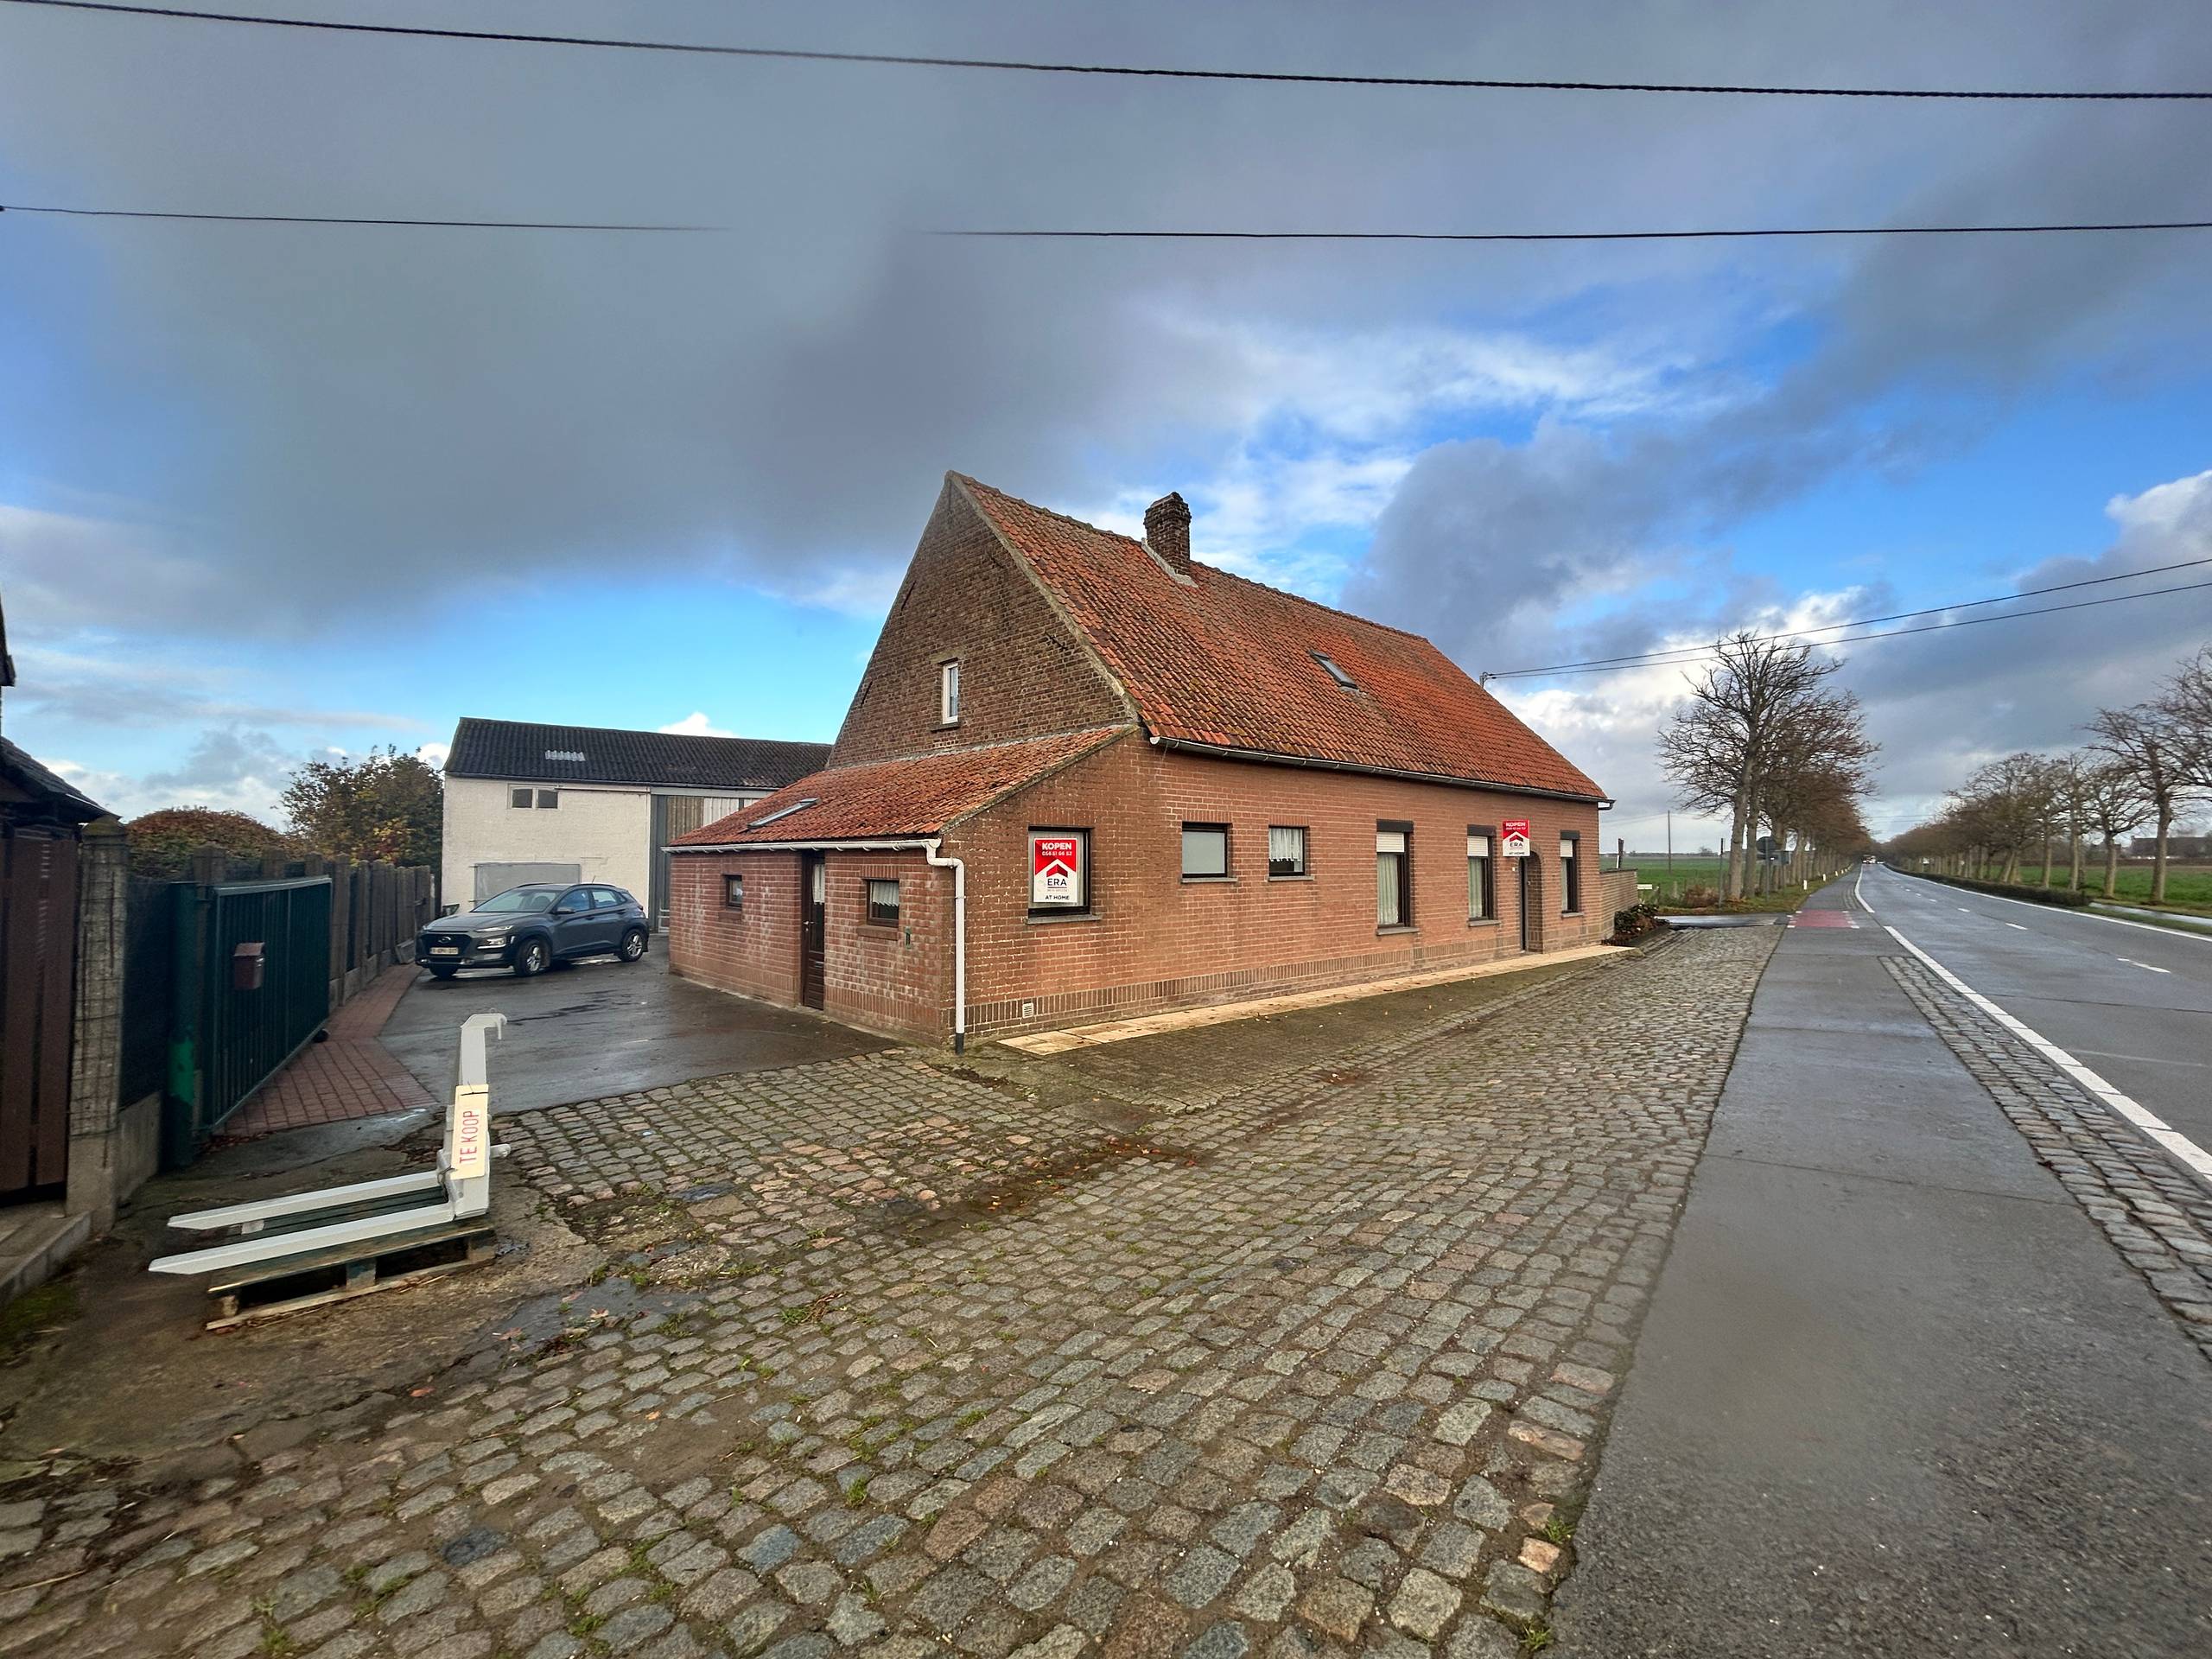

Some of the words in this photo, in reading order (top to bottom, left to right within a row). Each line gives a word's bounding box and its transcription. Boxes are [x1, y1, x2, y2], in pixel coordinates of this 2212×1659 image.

[1047, 878, 1067, 887] ERA
[461, 1110, 480, 1143] KOOP
[460, 1146, 478, 1164] TE
